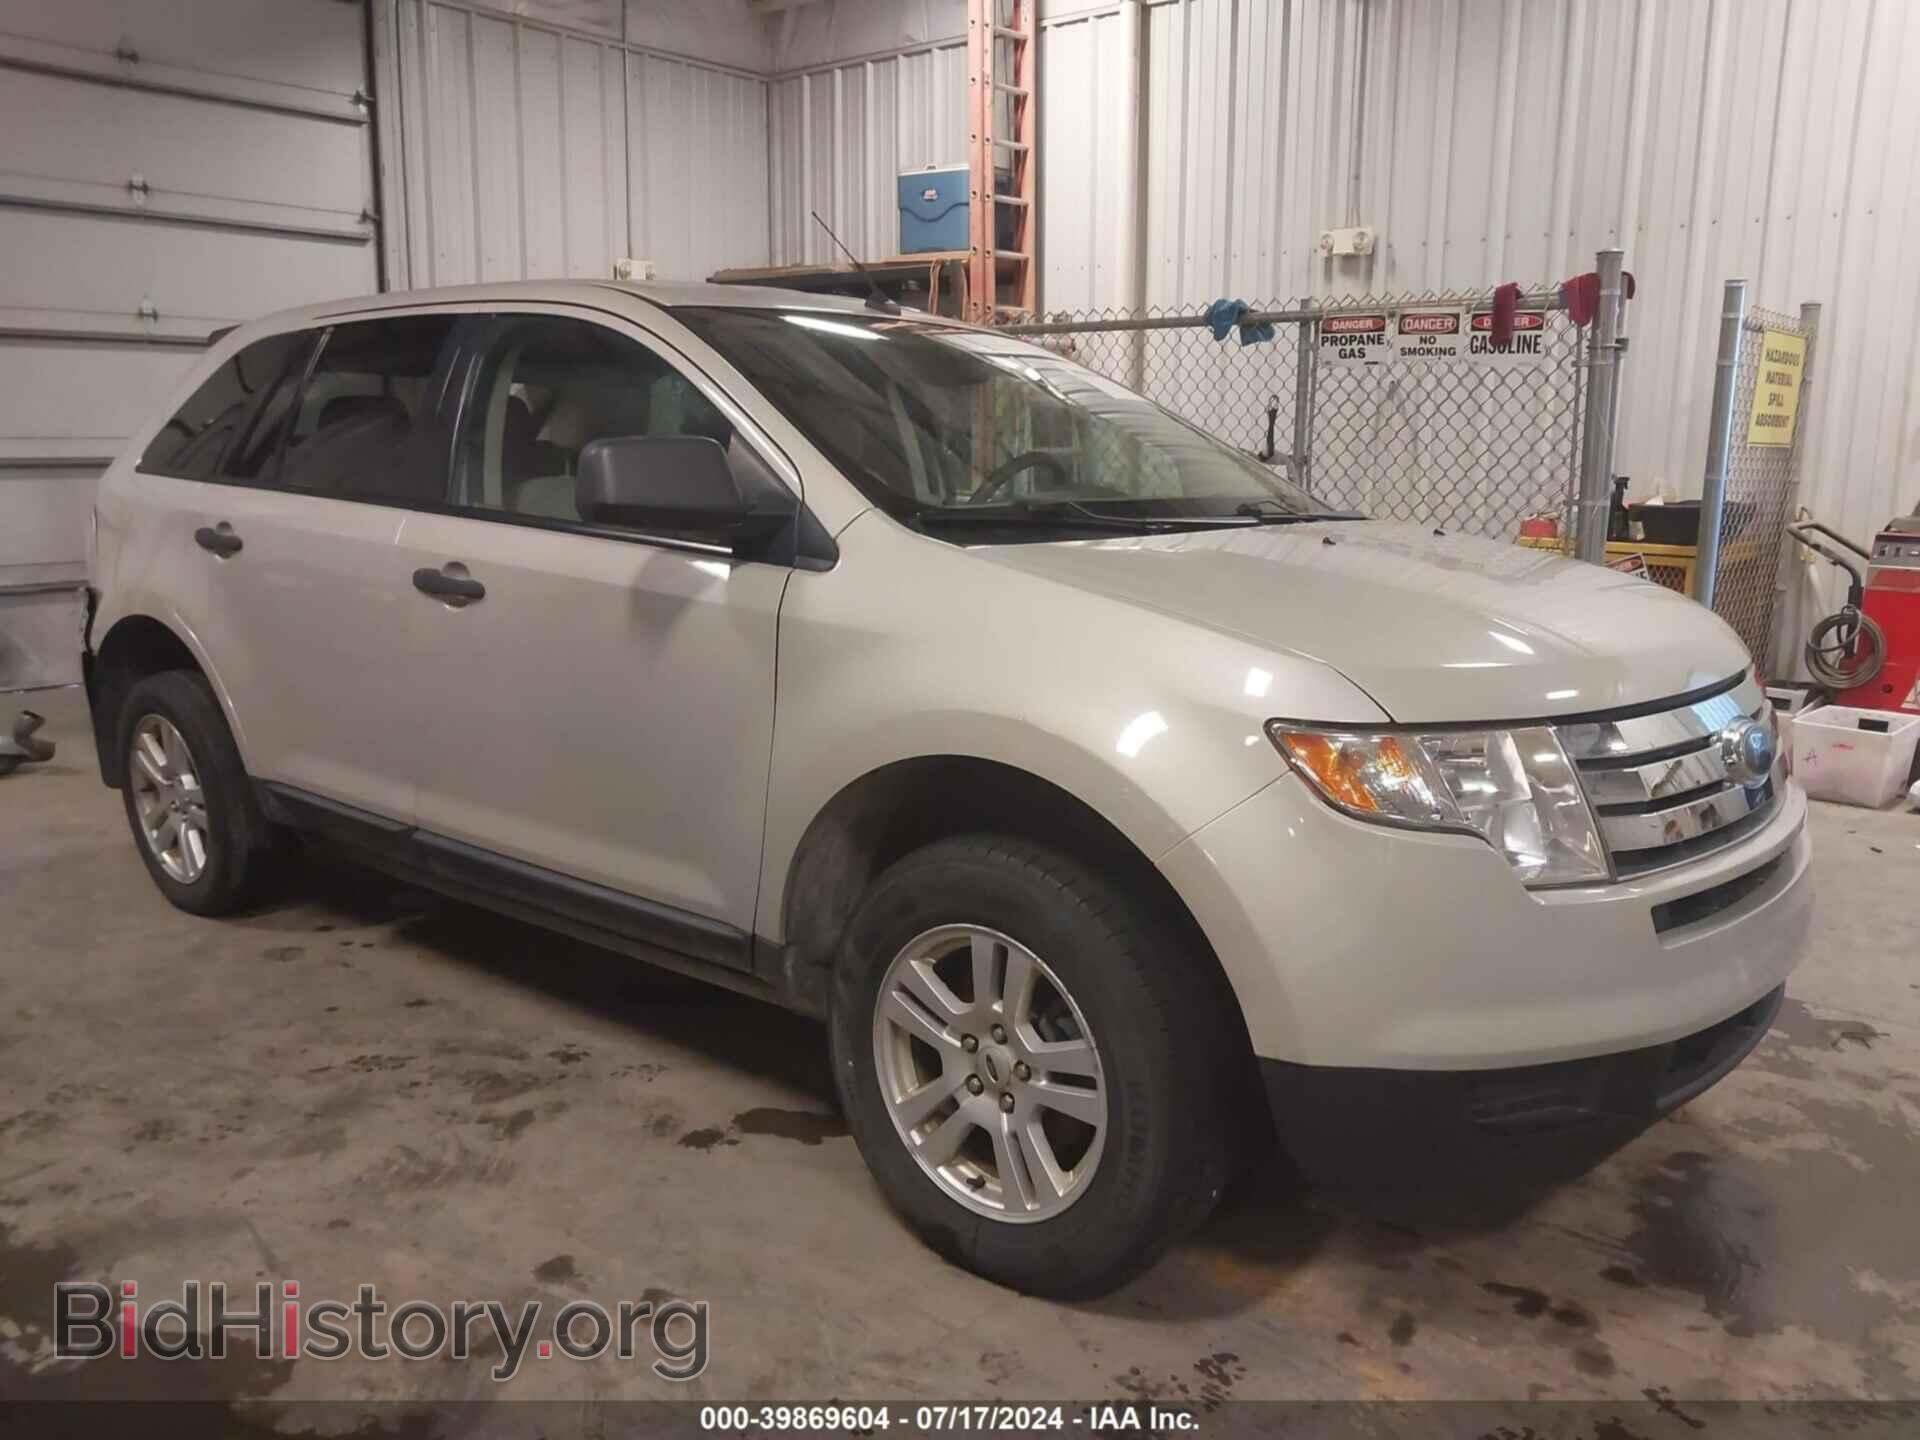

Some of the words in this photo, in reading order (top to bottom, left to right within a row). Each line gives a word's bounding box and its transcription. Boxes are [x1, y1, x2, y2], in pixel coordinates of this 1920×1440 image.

[1332, 319, 1373, 330] DANGER
[1405, 318, 1454, 331] DANGER
[1321, 334, 1385, 347] PROPANE
[1419, 335, 1437, 345] NO
[1338, 347, 1366, 359] GAS
[1400, 346, 1457, 357] SMOKING
[1765, 371, 1793, 387] MATERIAL
[1767, 392, 1784, 407] SPILL
